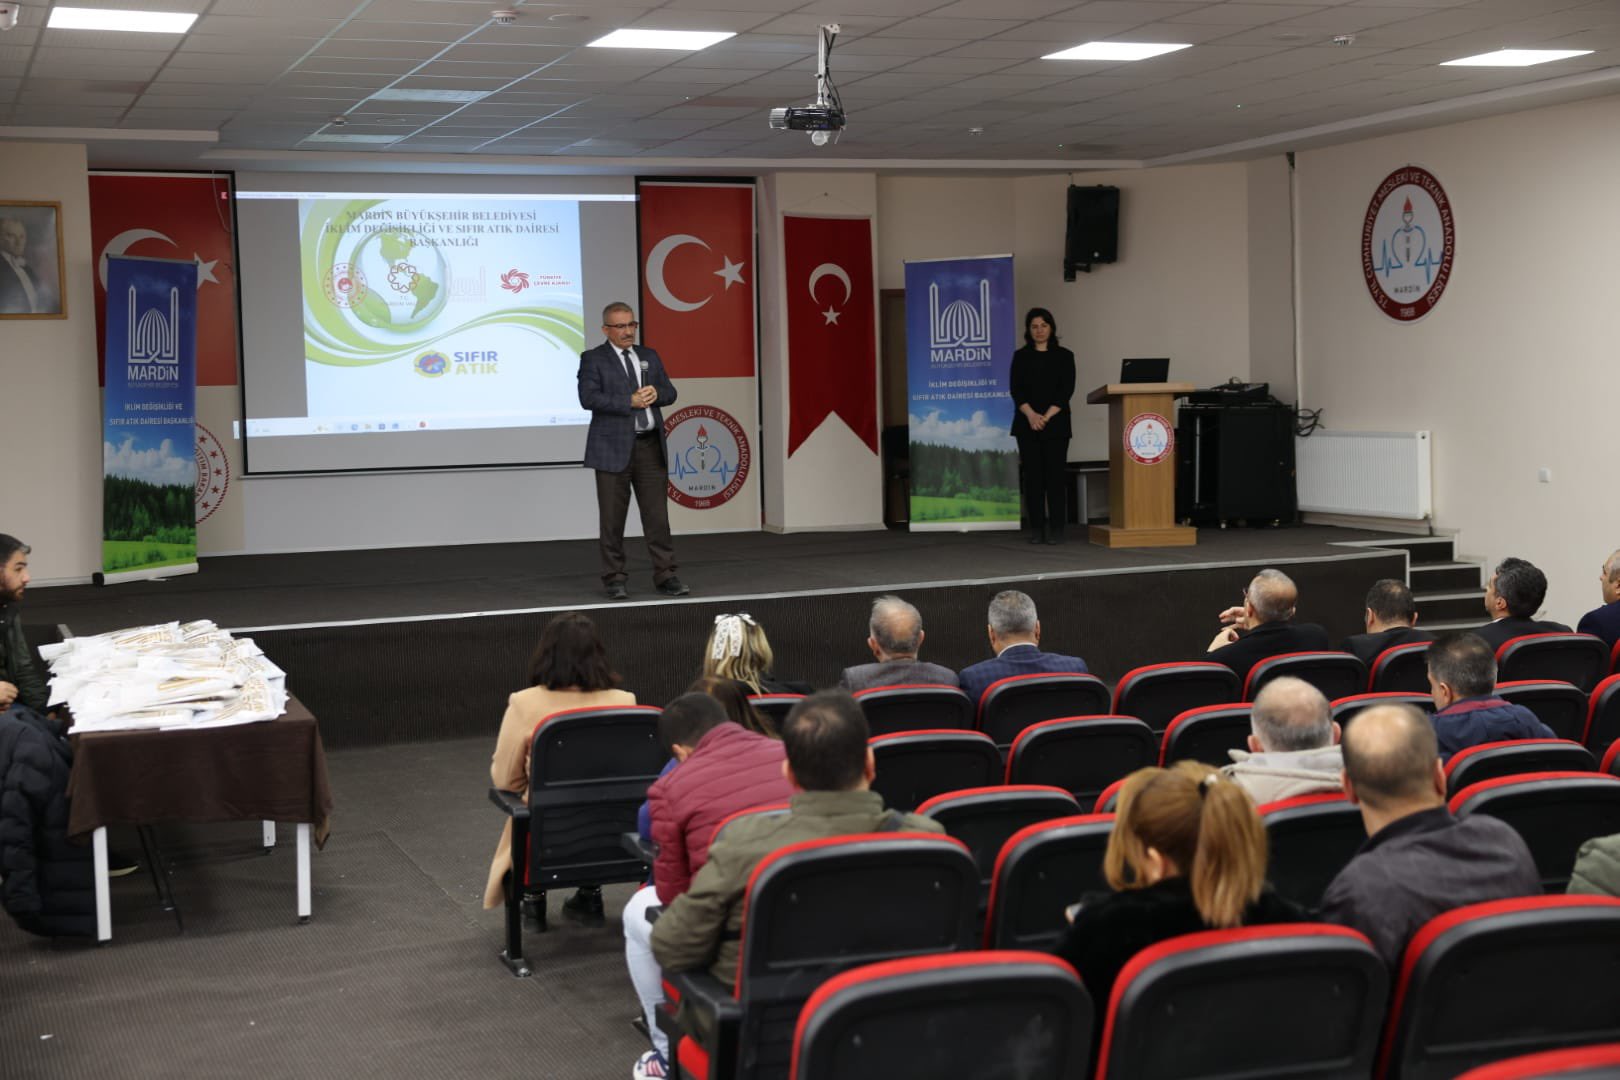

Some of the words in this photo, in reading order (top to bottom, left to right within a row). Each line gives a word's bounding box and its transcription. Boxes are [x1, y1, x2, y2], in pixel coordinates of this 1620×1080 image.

[1410, 172, 1421, 183] VE
[346, 209, 393, 220] MARDİN
[396, 209, 469, 221] BÜYÜKŞEHİR
[472, 209, 537, 220] BELEDİYESİ
[326, 222, 362, 233] İKLİM
[438, 224, 453, 233] VE
[456, 224, 485, 233] SIFIR
[488, 224, 513, 233] ATIK
[516, 222, 559, 233] DAİRESİ
[453, 351, 498, 362] SIFIR
[455, 363, 497, 375] ATIK
[703, 408, 714, 417] VE
